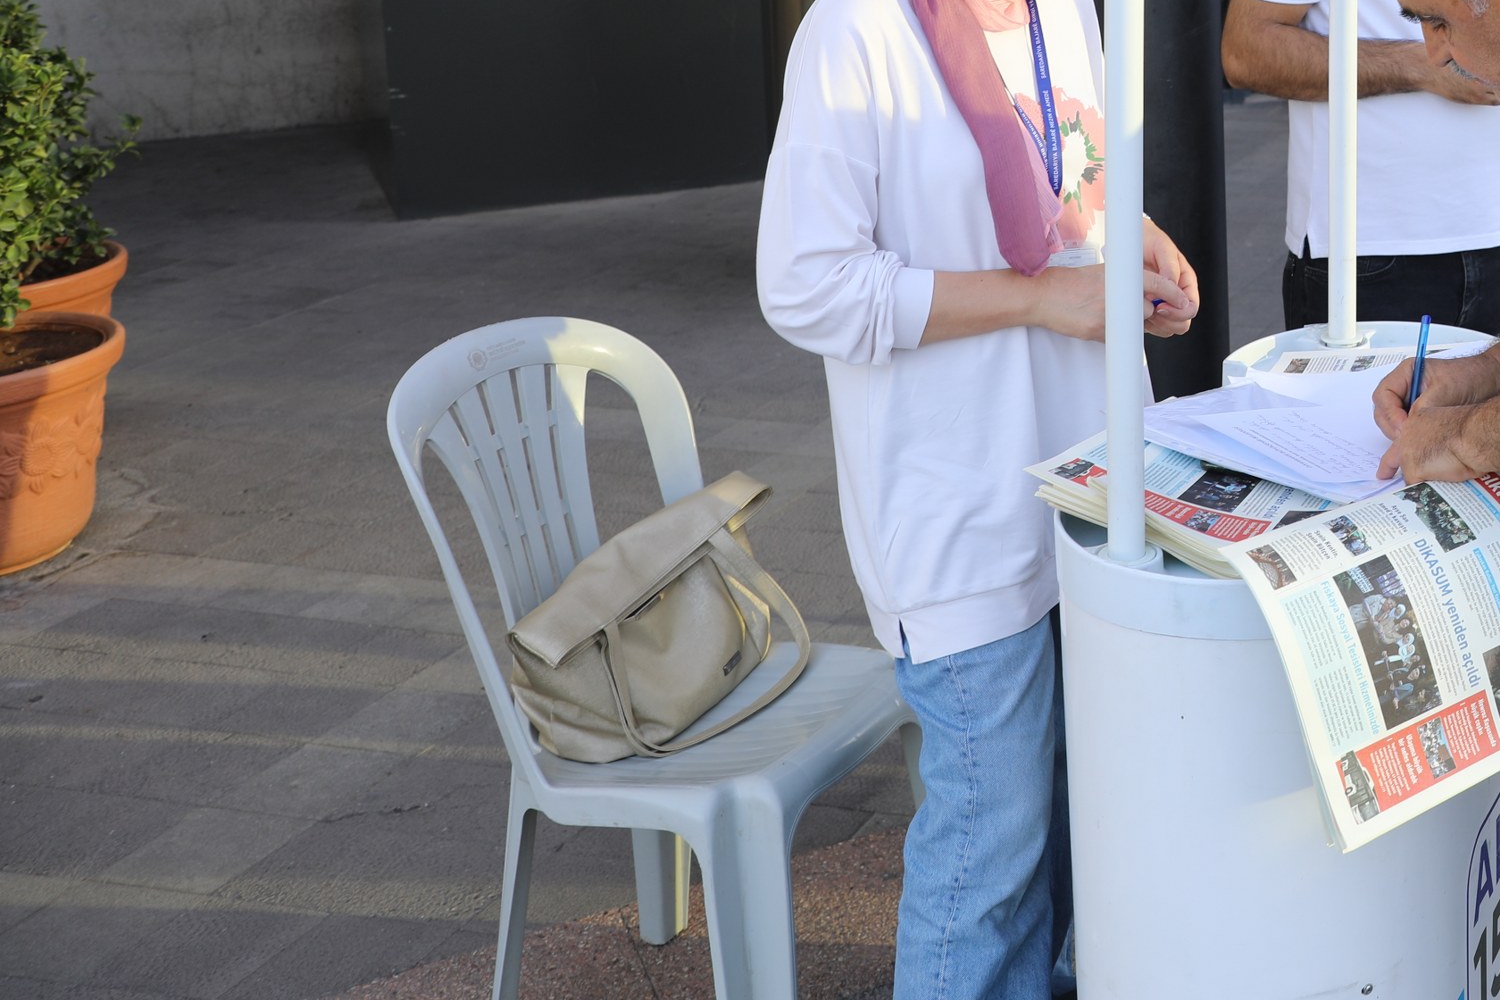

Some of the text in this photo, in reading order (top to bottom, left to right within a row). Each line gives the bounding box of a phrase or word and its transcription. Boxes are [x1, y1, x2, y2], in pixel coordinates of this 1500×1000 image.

[1321, 580, 1381, 736] Fiskaya Sosyal Tesisleri Hizmetinizde
[1413, 538, 1453, 597] DİKASUM
[1442, 597, 1471, 651] yeniden
[1459, 650, 1481, 688] açıldı
